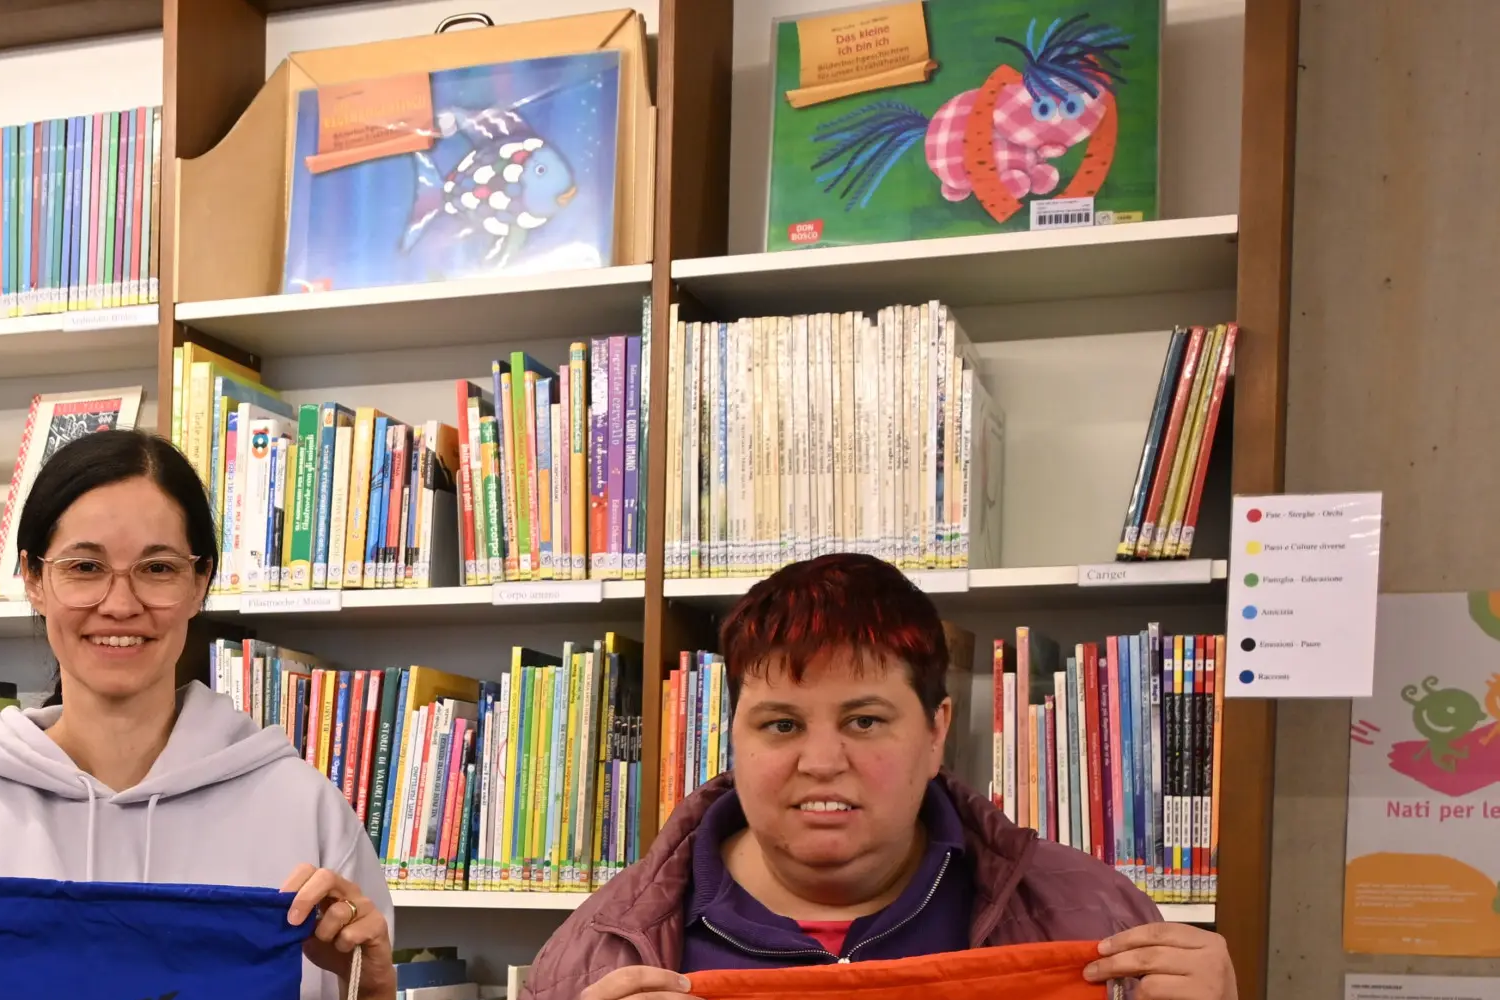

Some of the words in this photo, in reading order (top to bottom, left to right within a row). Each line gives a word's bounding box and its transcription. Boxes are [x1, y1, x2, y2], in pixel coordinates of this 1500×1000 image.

[836, 34, 856, 45] Das
[859, 25, 889, 39] kleine
[856, 41, 873, 53] bin
[791, 230, 818, 241] BOSCO
[796, 223, 815, 233] DON
[611, 397, 626, 445] cervello
[625, 417, 637, 442] CORPO
[625, 443, 636, 471] UMANO
[488, 522, 500, 557] corpo
[499, 590, 527, 601] Corpo
[378, 722, 392, 754] STORIE
[374, 768, 386, 799] VALORI
[407, 765, 419, 802] FRATELLINO
[1386, 800, 1430, 819] Nati
[1439, 804, 1475, 823] per
